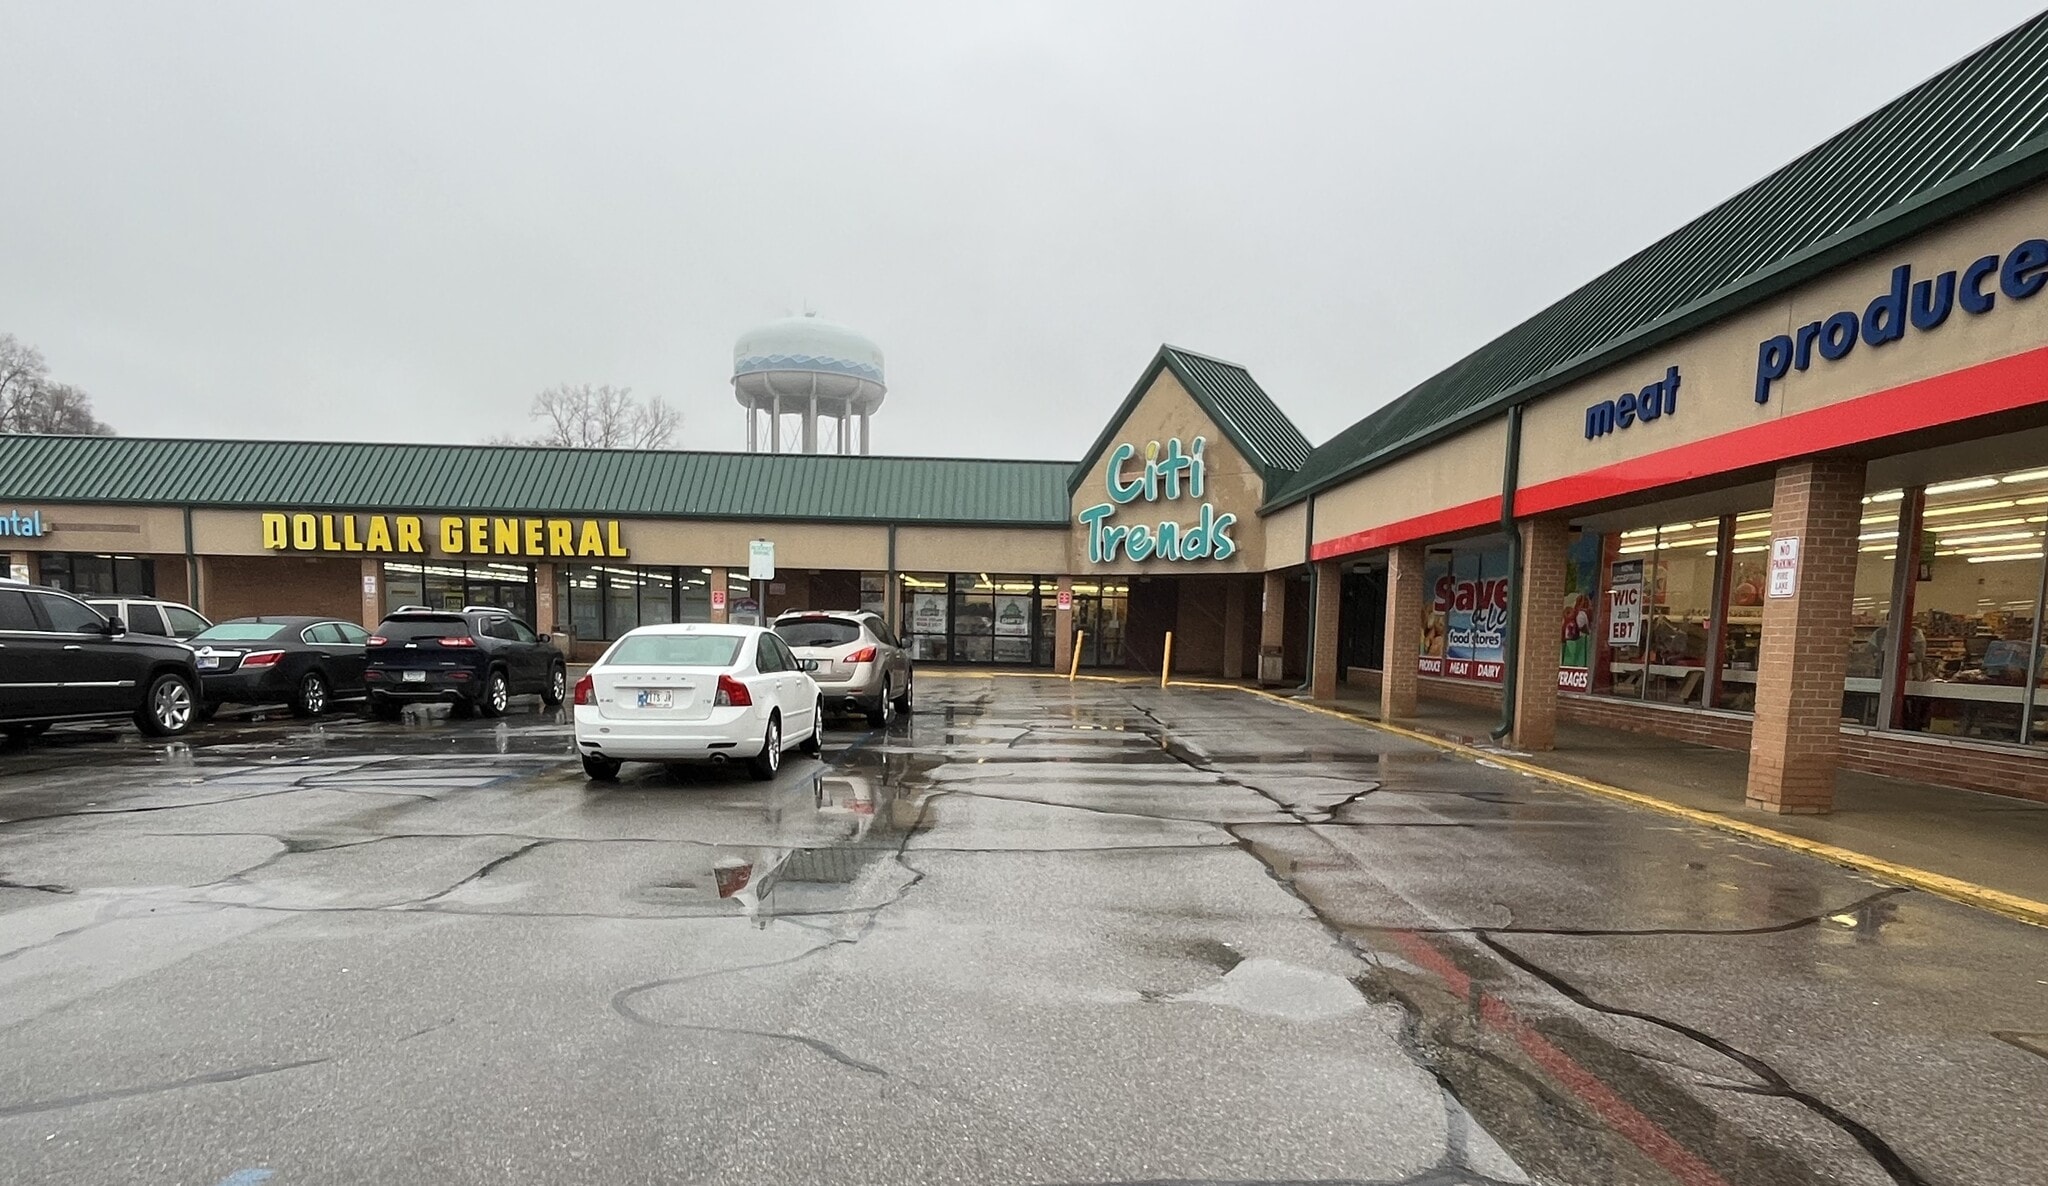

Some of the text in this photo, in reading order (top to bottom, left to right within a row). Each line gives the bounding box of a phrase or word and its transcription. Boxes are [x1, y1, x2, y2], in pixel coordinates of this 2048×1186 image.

[1585, 239, 2048, 440] meat produce
[1106, 436, 1206, 504] Citi
[262, 513, 629, 558] DOLLAR GENERAL
[1078, 503, 1237, 563] Trends
[1780, 544, 1791, 556] NO
[1776, 572, 1789, 580] FIRE
[1434, 576, 1508, 613] Save
[1774, 582, 1789, 590] LANE
[1614, 588, 1638, 606] WIC
[1618, 608, 1630, 619] and
[1450, 630, 1500, 646] food stores
[1613, 622, 1635, 639] EBT
[1419, 659, 1501, 678] PRODUCE MEAT DAIRY
